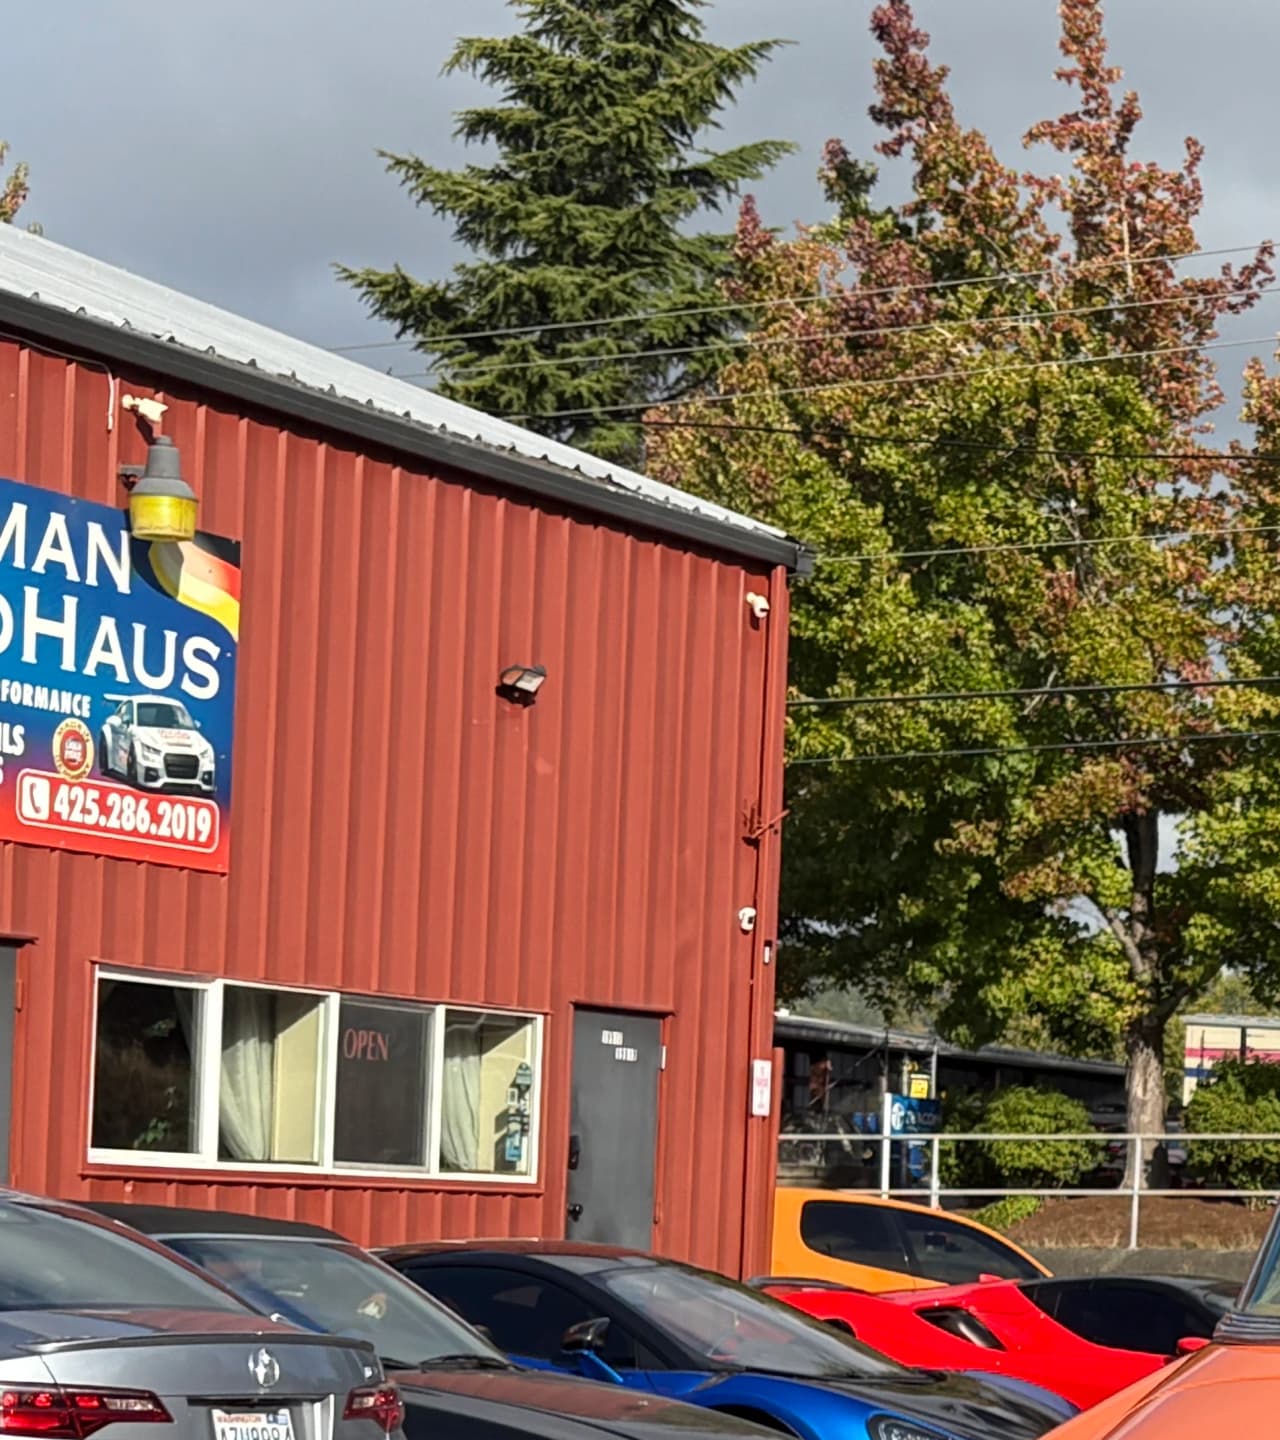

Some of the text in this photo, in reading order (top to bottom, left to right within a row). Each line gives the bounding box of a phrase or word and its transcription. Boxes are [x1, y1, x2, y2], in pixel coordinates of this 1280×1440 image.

[0, 585, 221, 700] HAUS
[0, 721, 25, 756] LS
[54, 784, 211, 842] 425.286.2019
[343, 1028, 389, 1061] OPEN
